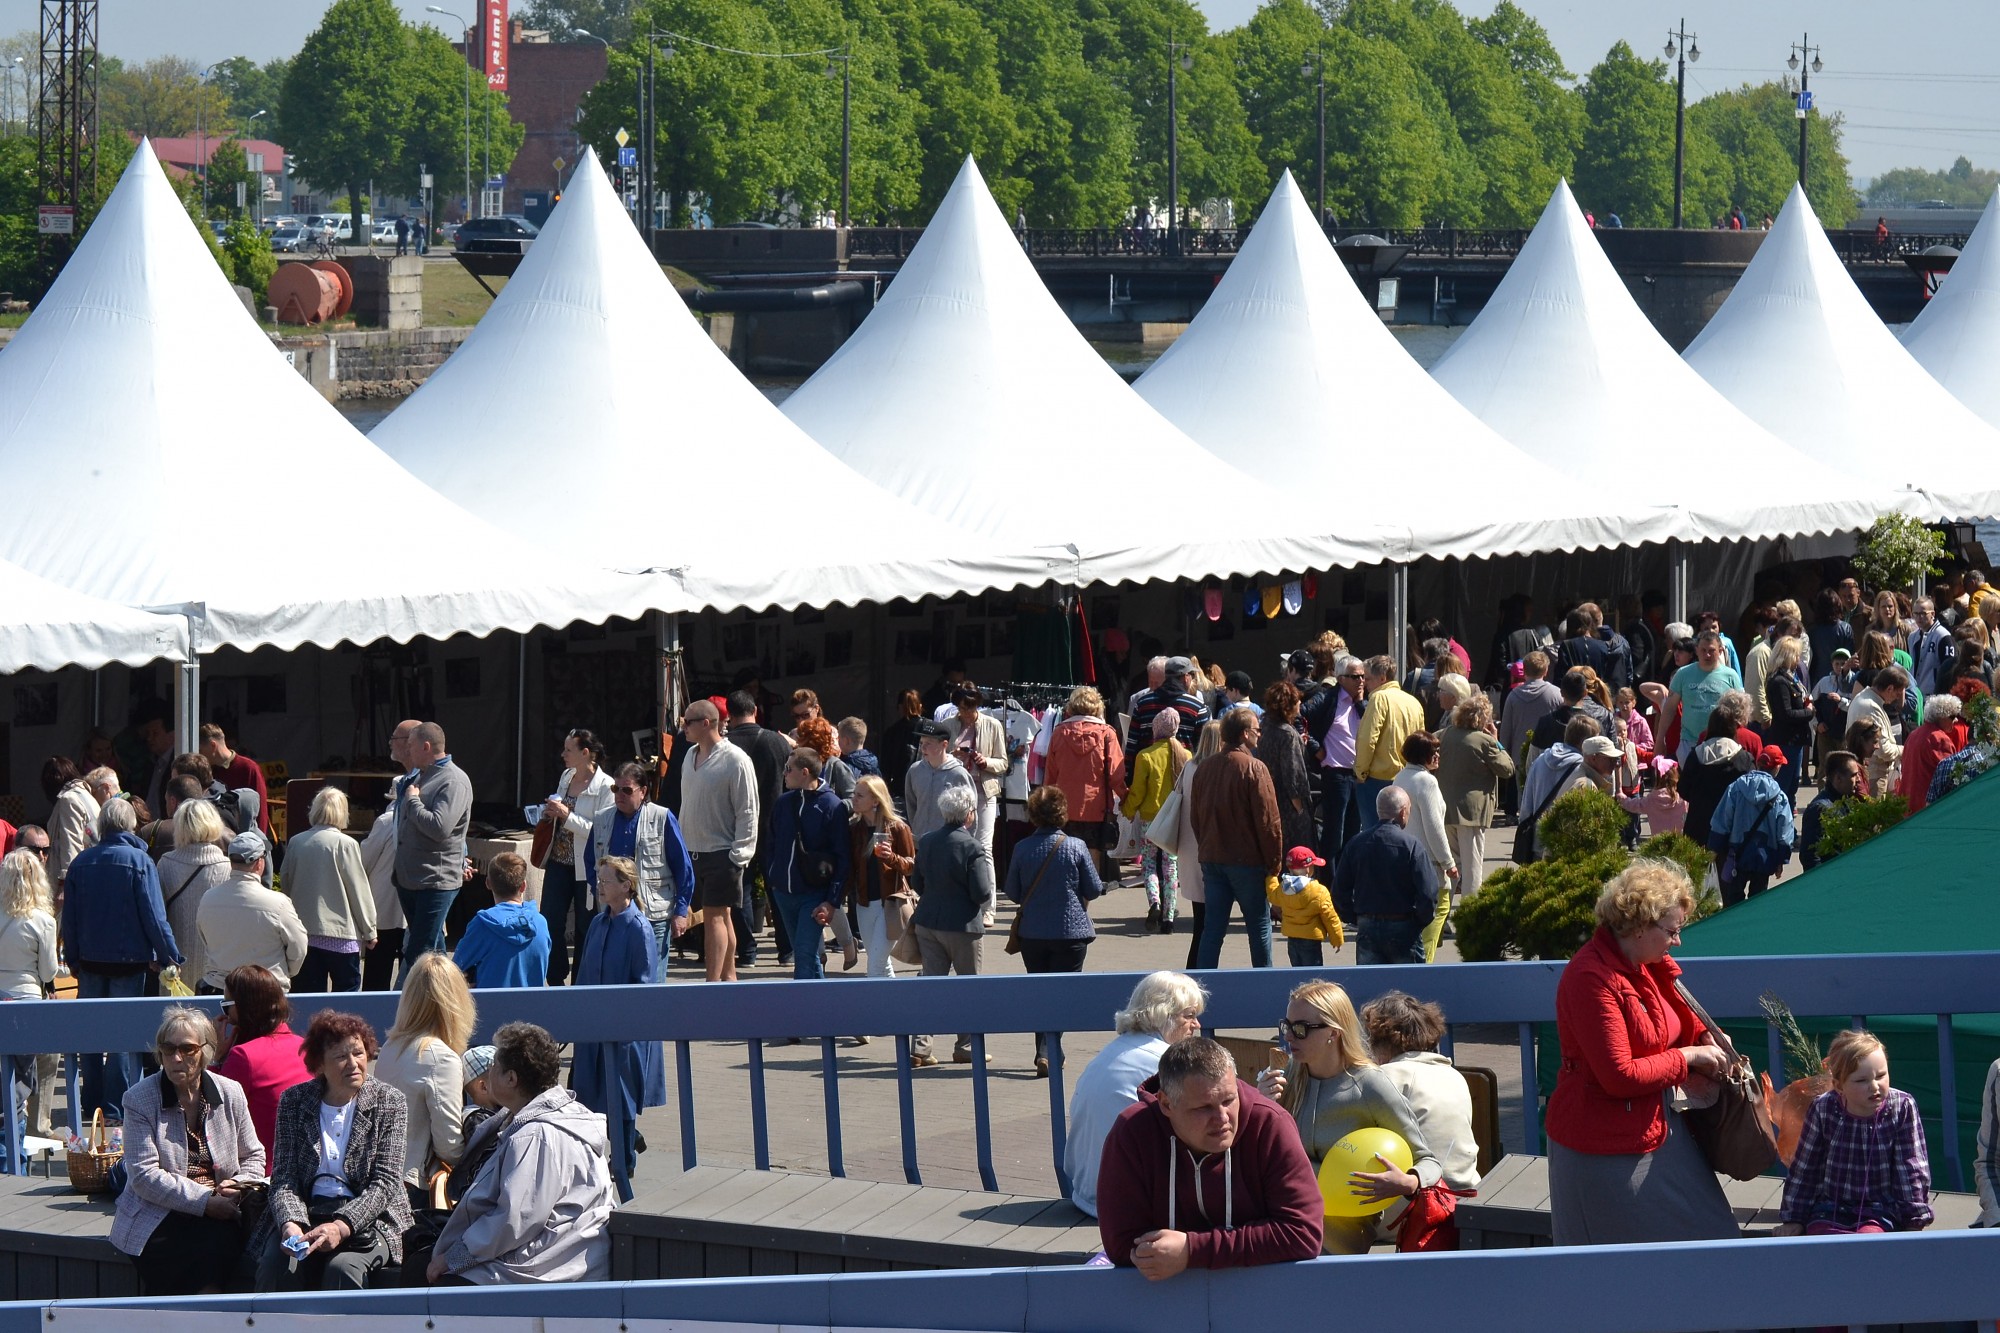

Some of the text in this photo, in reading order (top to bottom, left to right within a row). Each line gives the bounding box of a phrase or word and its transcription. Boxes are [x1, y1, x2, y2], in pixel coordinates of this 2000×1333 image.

[1928, 641, 1936, 653] R
[1944, 645, 1955, 658] 13
[1336, 1141, 1359, 1154] DEN
